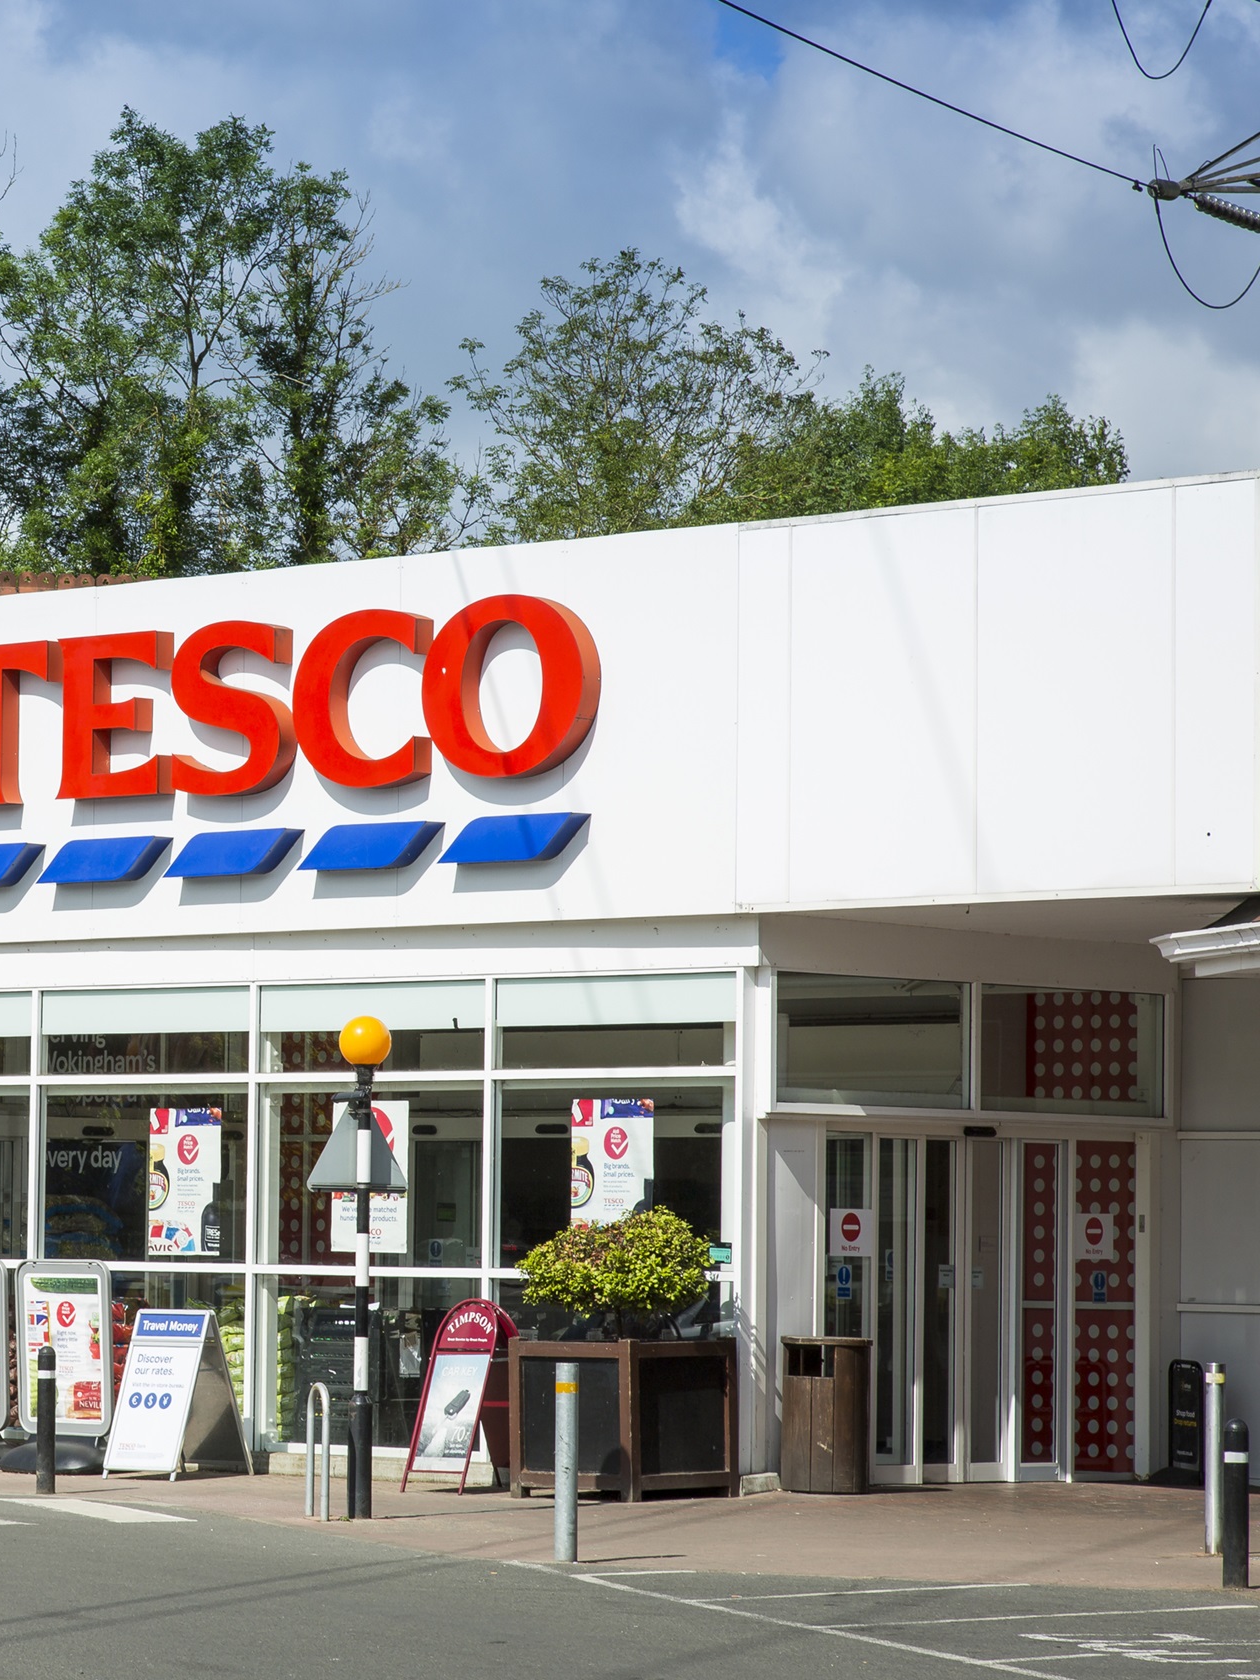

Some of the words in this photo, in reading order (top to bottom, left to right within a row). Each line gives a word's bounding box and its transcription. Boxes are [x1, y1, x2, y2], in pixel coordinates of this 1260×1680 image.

[45, 1150, 87, 1174] very
[90, 1145, 122, 1174] day
[604, 1163, 612, 1171] Big
[618, 1171, 635, 1179] prices.
[849, 1245, 860, 1253] Entry
[142, 1320, 168, 1331] Travel
[447, 1311, 494, 1334] TIMPSON
[137, 1353, 173, 1364] Discover
[135, 1367, 149, 1375] our
[151, 1366, 174, 1376] rates.
[442, 1366, 460, 1377] CAR
[460, 1366, 479, 1377] KEY
[1176, 1409, 1186, 1418] Shop
